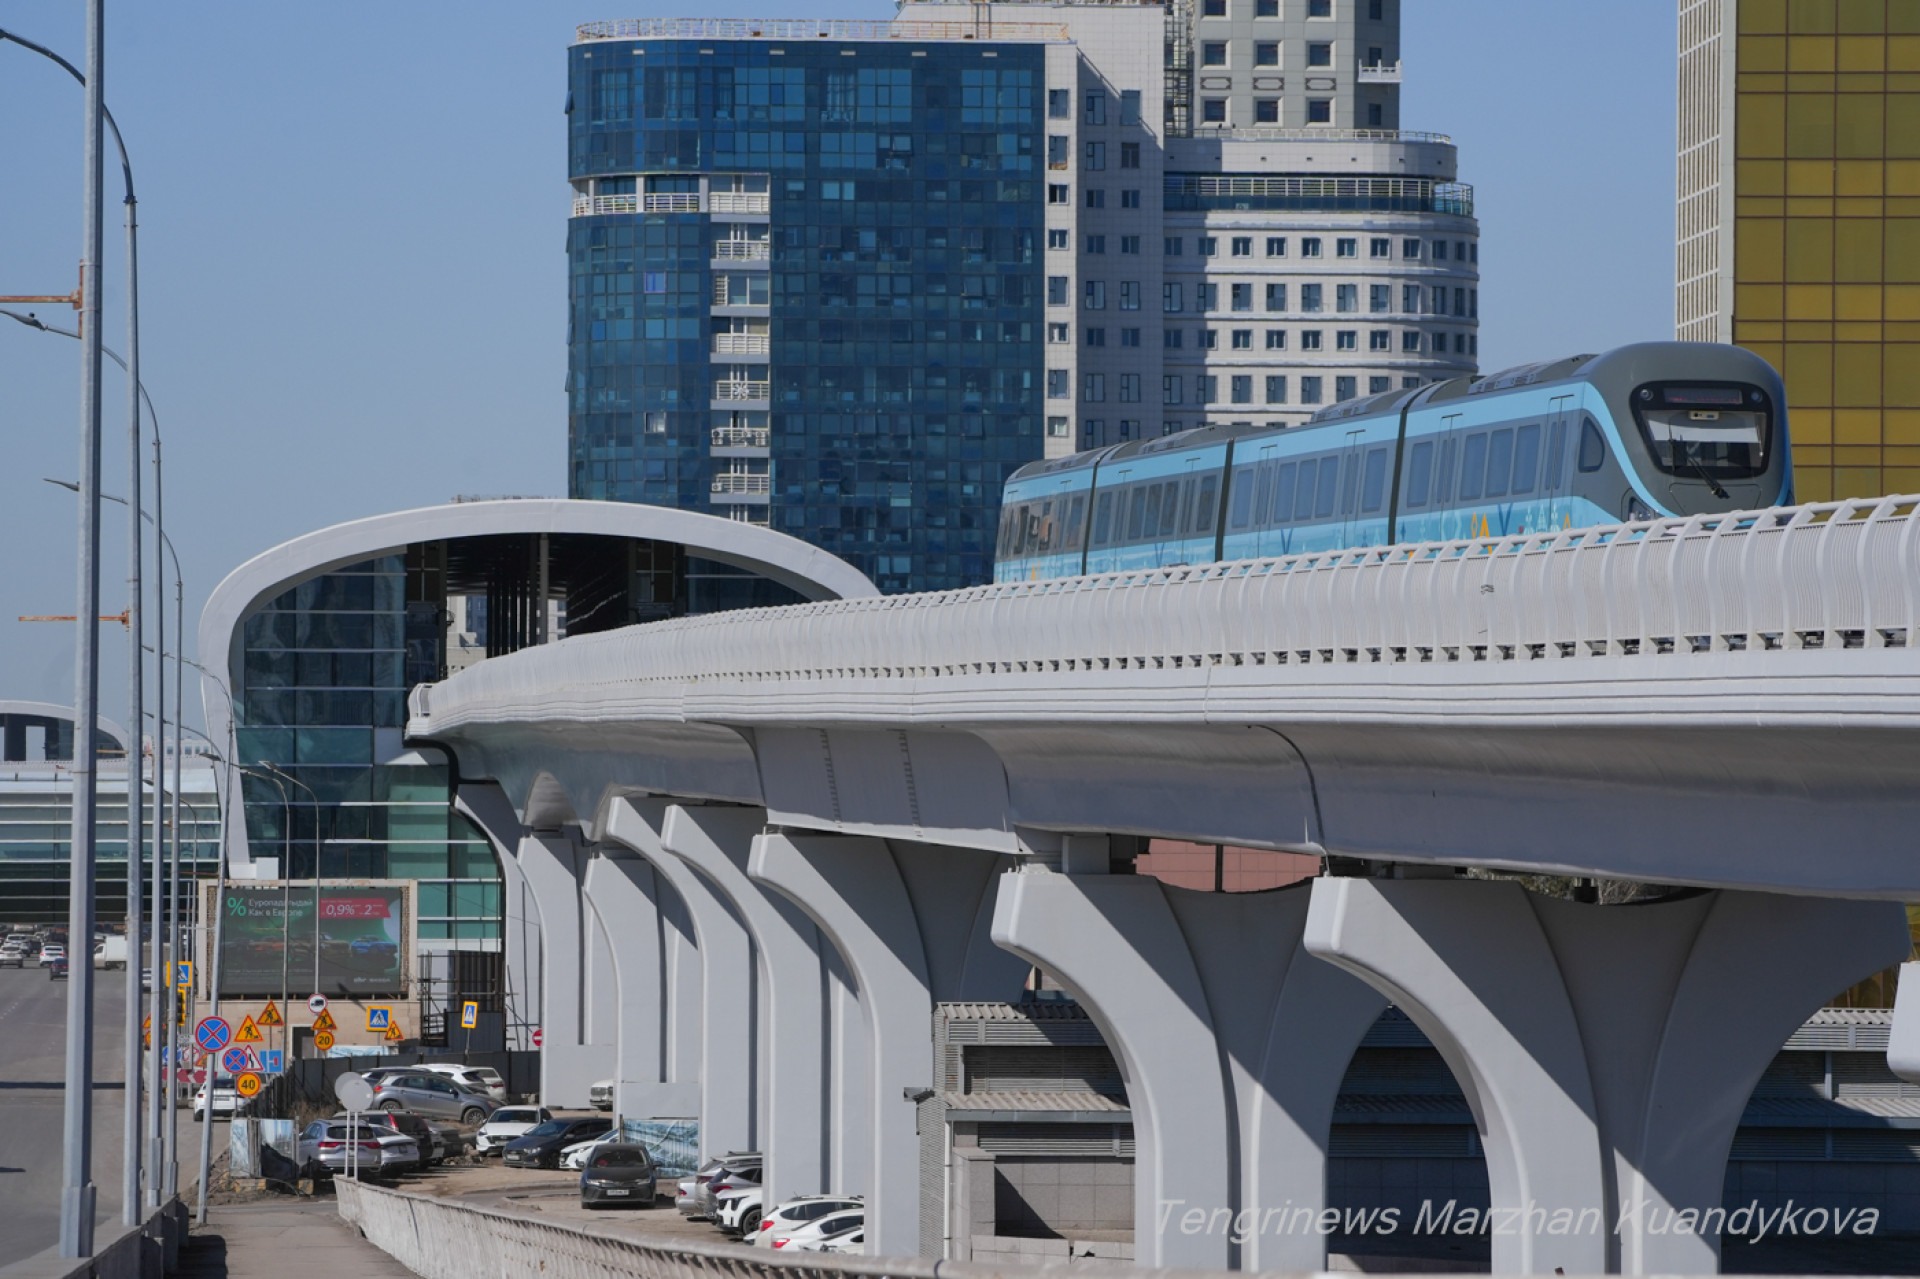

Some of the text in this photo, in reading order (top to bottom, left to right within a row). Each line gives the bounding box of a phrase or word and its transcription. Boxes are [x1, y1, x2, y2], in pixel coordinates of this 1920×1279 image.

[227, 897, 247, 916] %
[326, 904, 355, 917] 0,9%
[364, 904, 372, 915] 2
[318, 1036, 330, 1045] 20
[241, 1080, 256, 1089] 40
